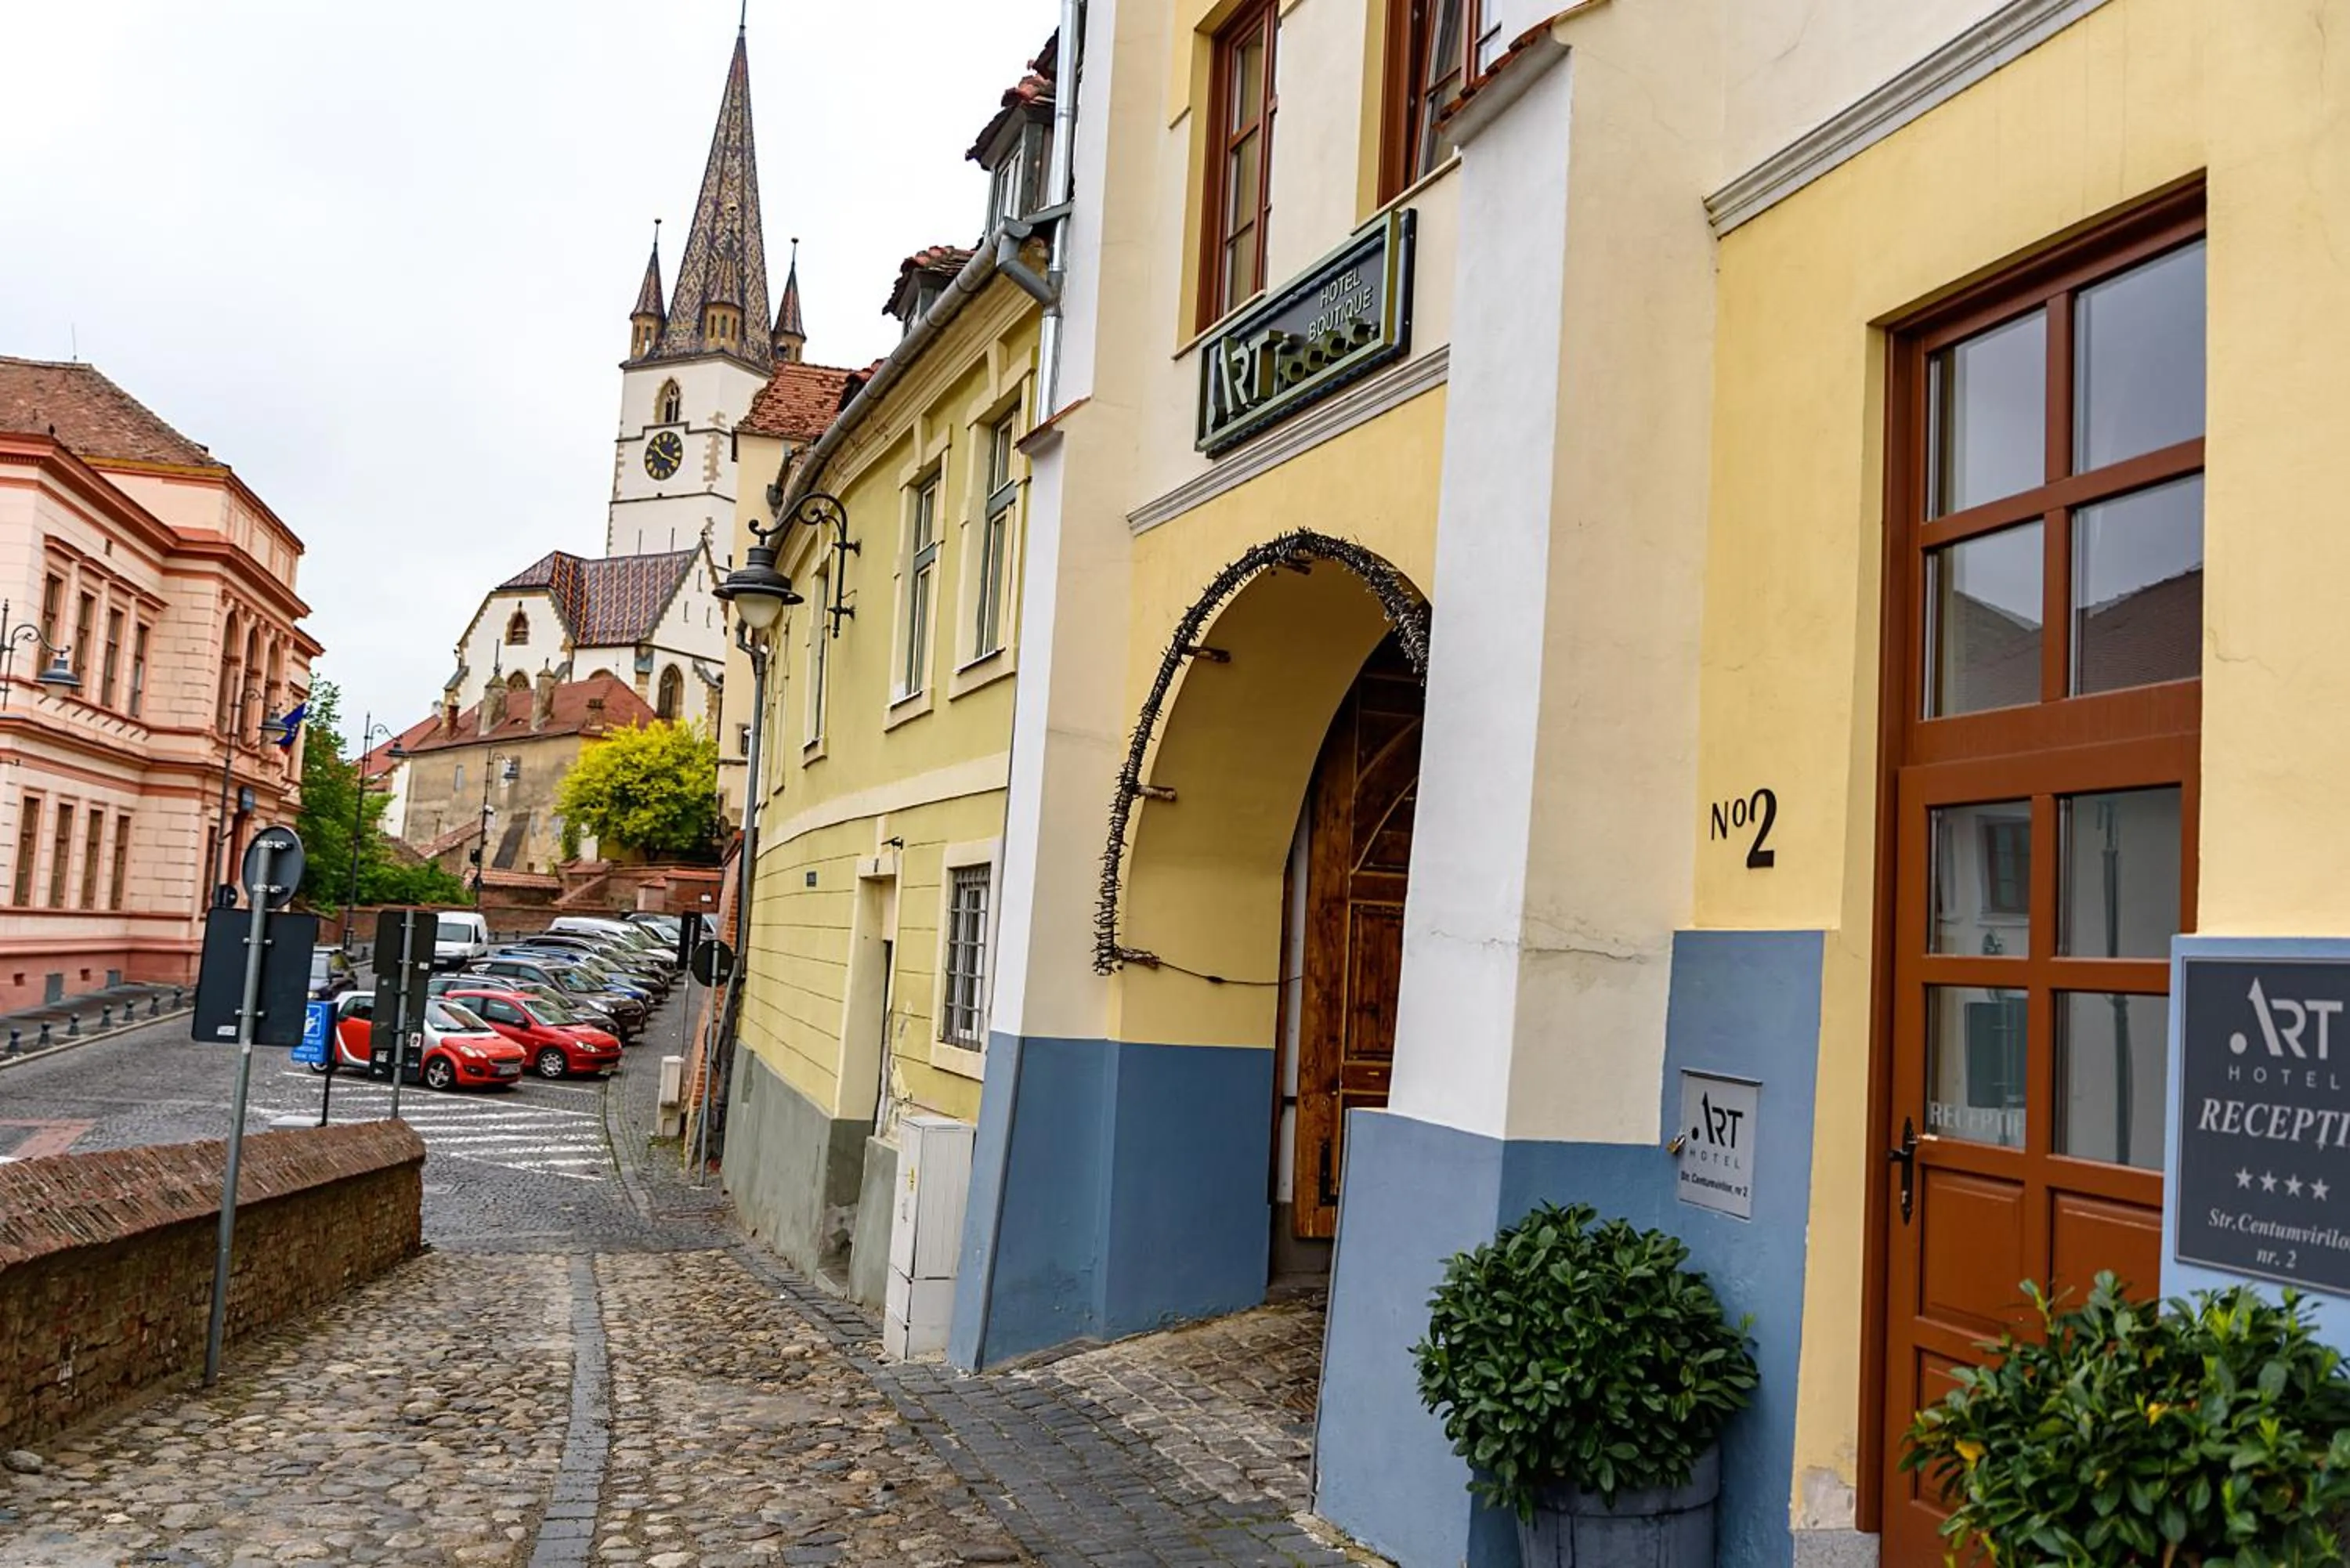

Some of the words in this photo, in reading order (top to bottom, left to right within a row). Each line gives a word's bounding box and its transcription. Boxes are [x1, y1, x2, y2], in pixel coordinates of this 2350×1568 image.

[1319, 267, 1361, 308] HOTEL
[1308, 287, 1373, 341] BOUTIQUE
[2229, 977, 2343, 1060] ART
[2229, 1065, 2341, 1090] HOTEL
[1692, 1091, 1744, 1148] ART
[2198, 1098, 2350, 1152] RECEPȚI
[1690, 1149, 1741, 1169] HOTEL
[2208, 1208, 2350, 1251] Str.Centumvirilo
[2257, 1248, 2280, 1266] nr.
[2286, 1249, 2297, 1269] 2
